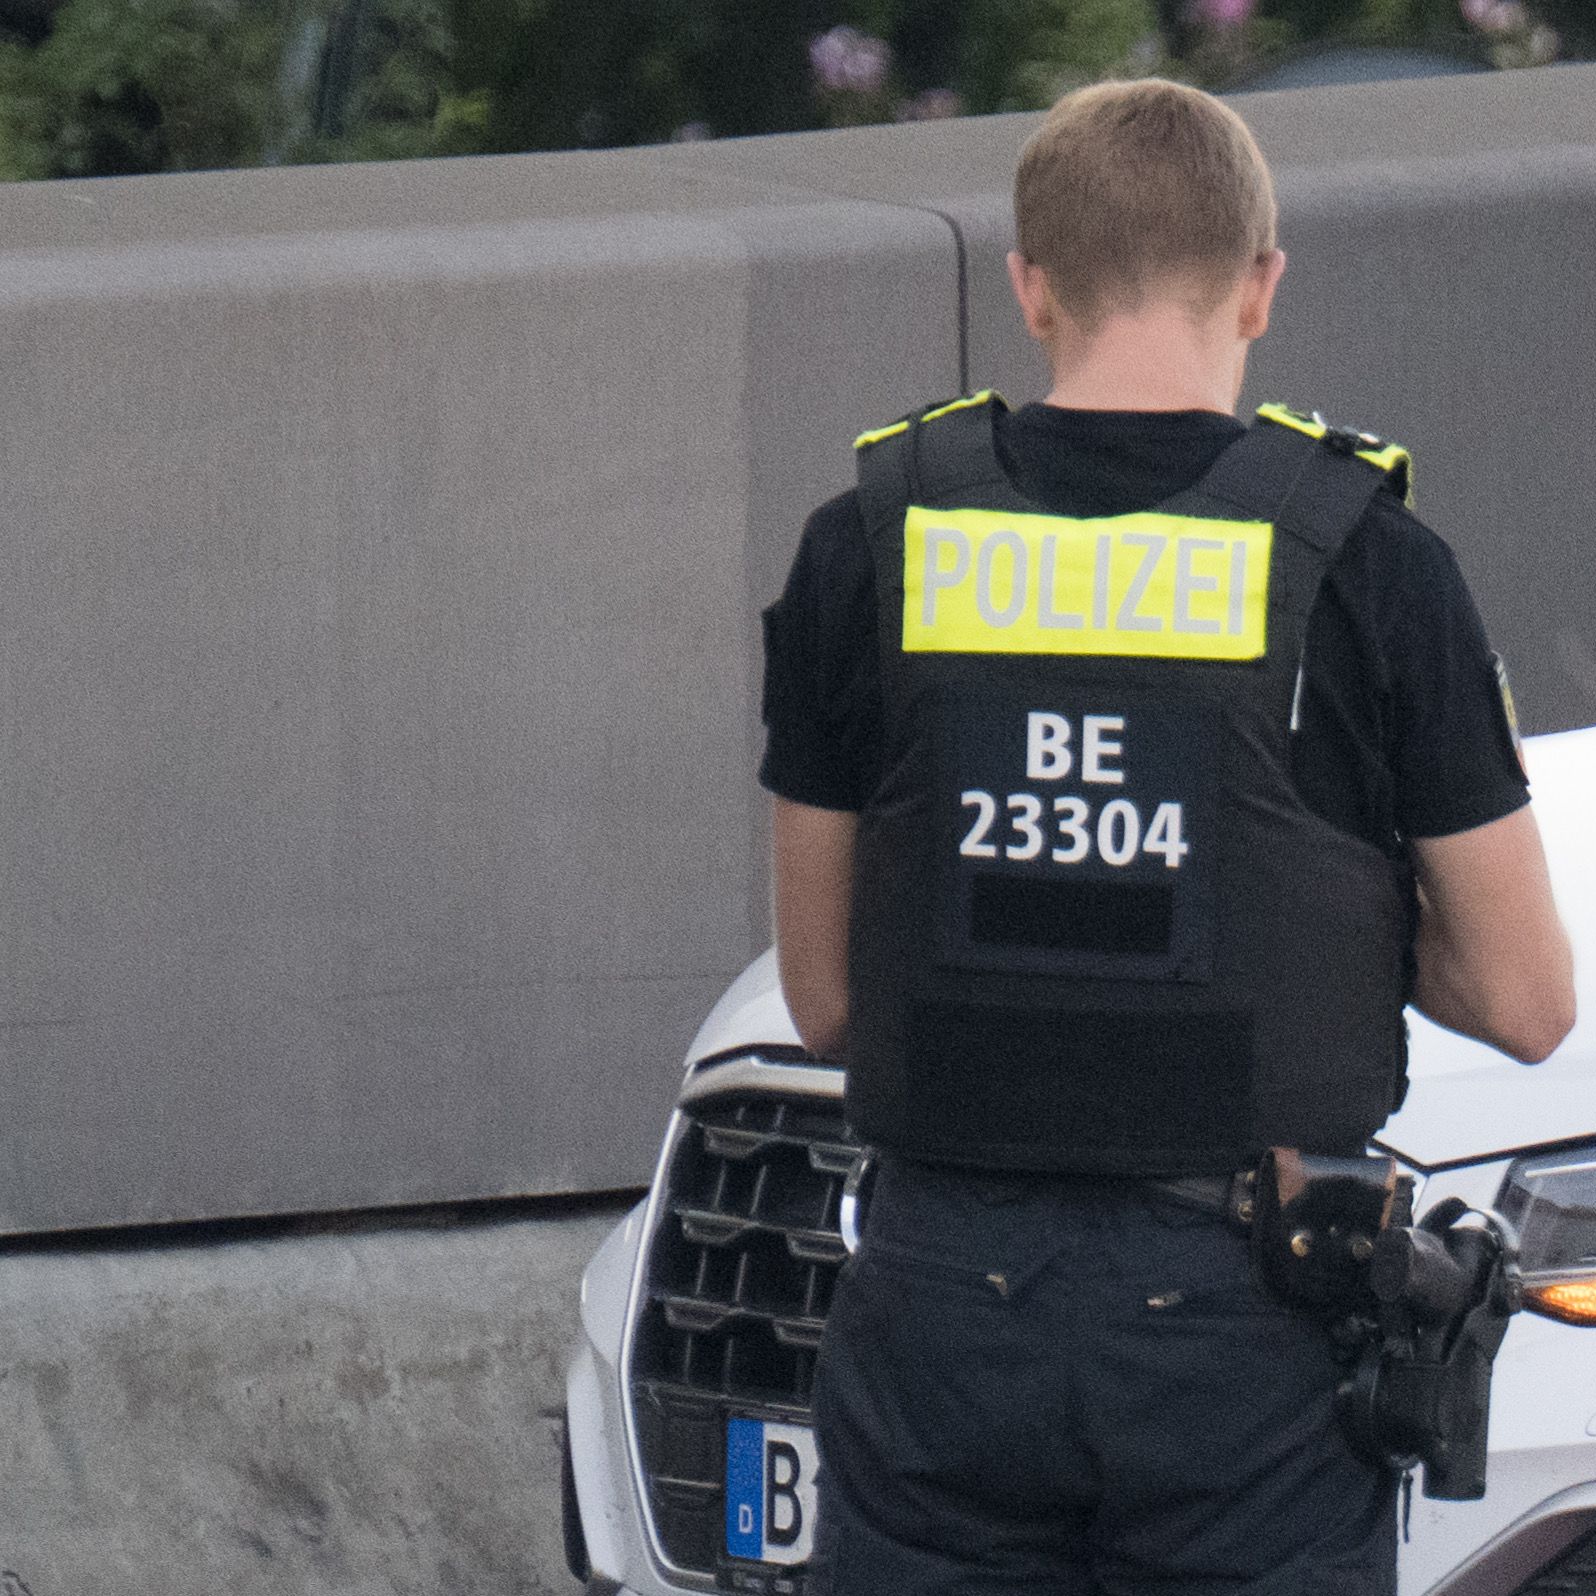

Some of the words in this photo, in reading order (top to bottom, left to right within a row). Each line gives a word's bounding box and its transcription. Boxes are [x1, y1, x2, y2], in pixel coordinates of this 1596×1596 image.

[919, 526, 1247, 636] POLIZEI
[1026, 712, 1125, 783] BE
[959, 791, 1188, 868] 23304
[739, 1504, 753, 1533] D
[767, 1441, 801, 1547] B
